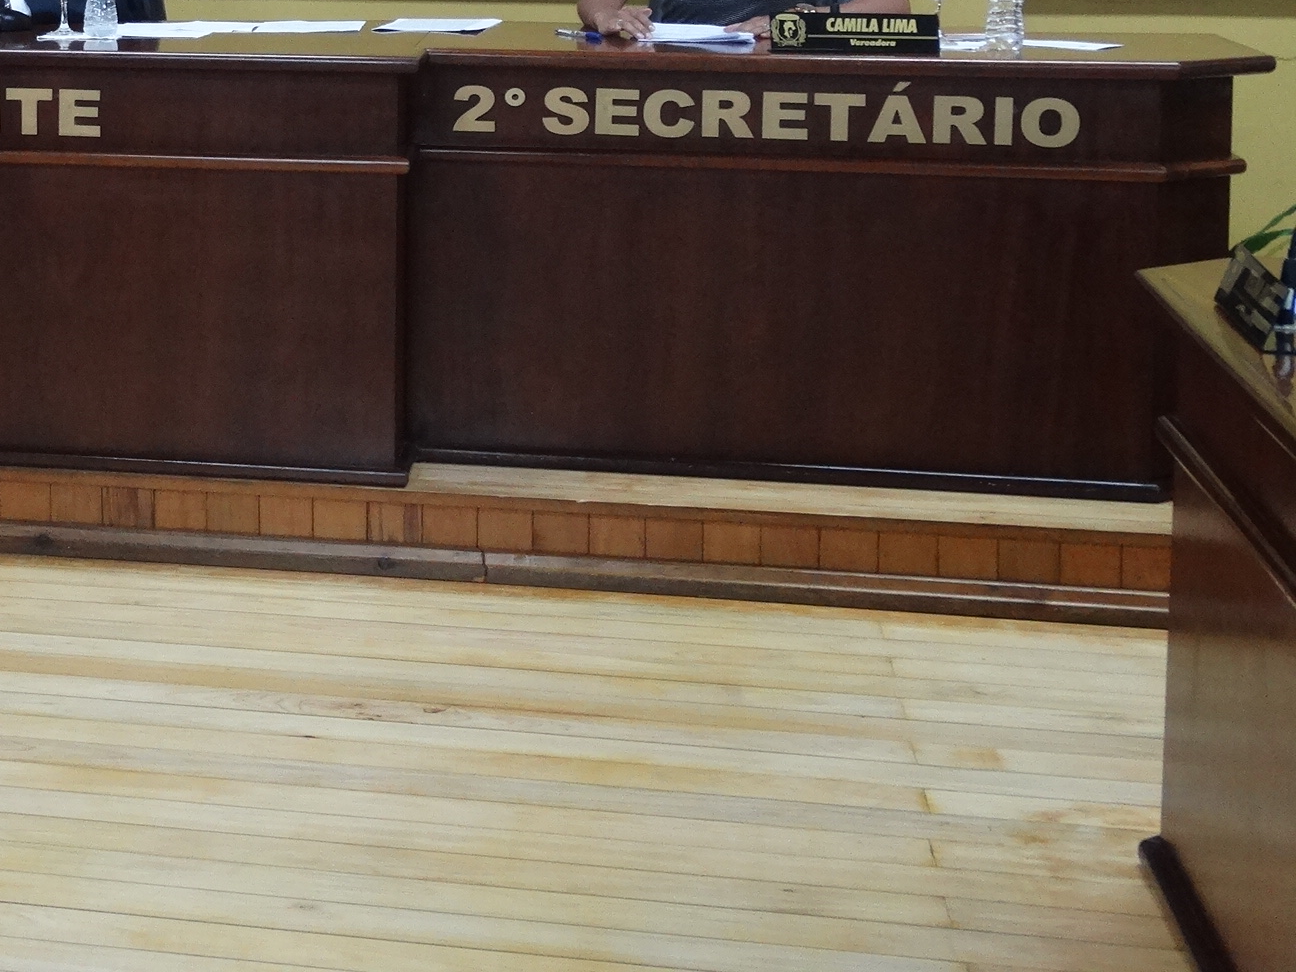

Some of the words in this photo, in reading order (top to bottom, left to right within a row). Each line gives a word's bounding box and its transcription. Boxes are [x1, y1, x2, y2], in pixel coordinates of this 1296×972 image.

[826, 17, 879, 33] CAMILA
[882, 18, 918, 34] LIMA
[849, 38, 897, 47] Vereadora
[541, 81, 1081, 148] SECRETÁRIO
